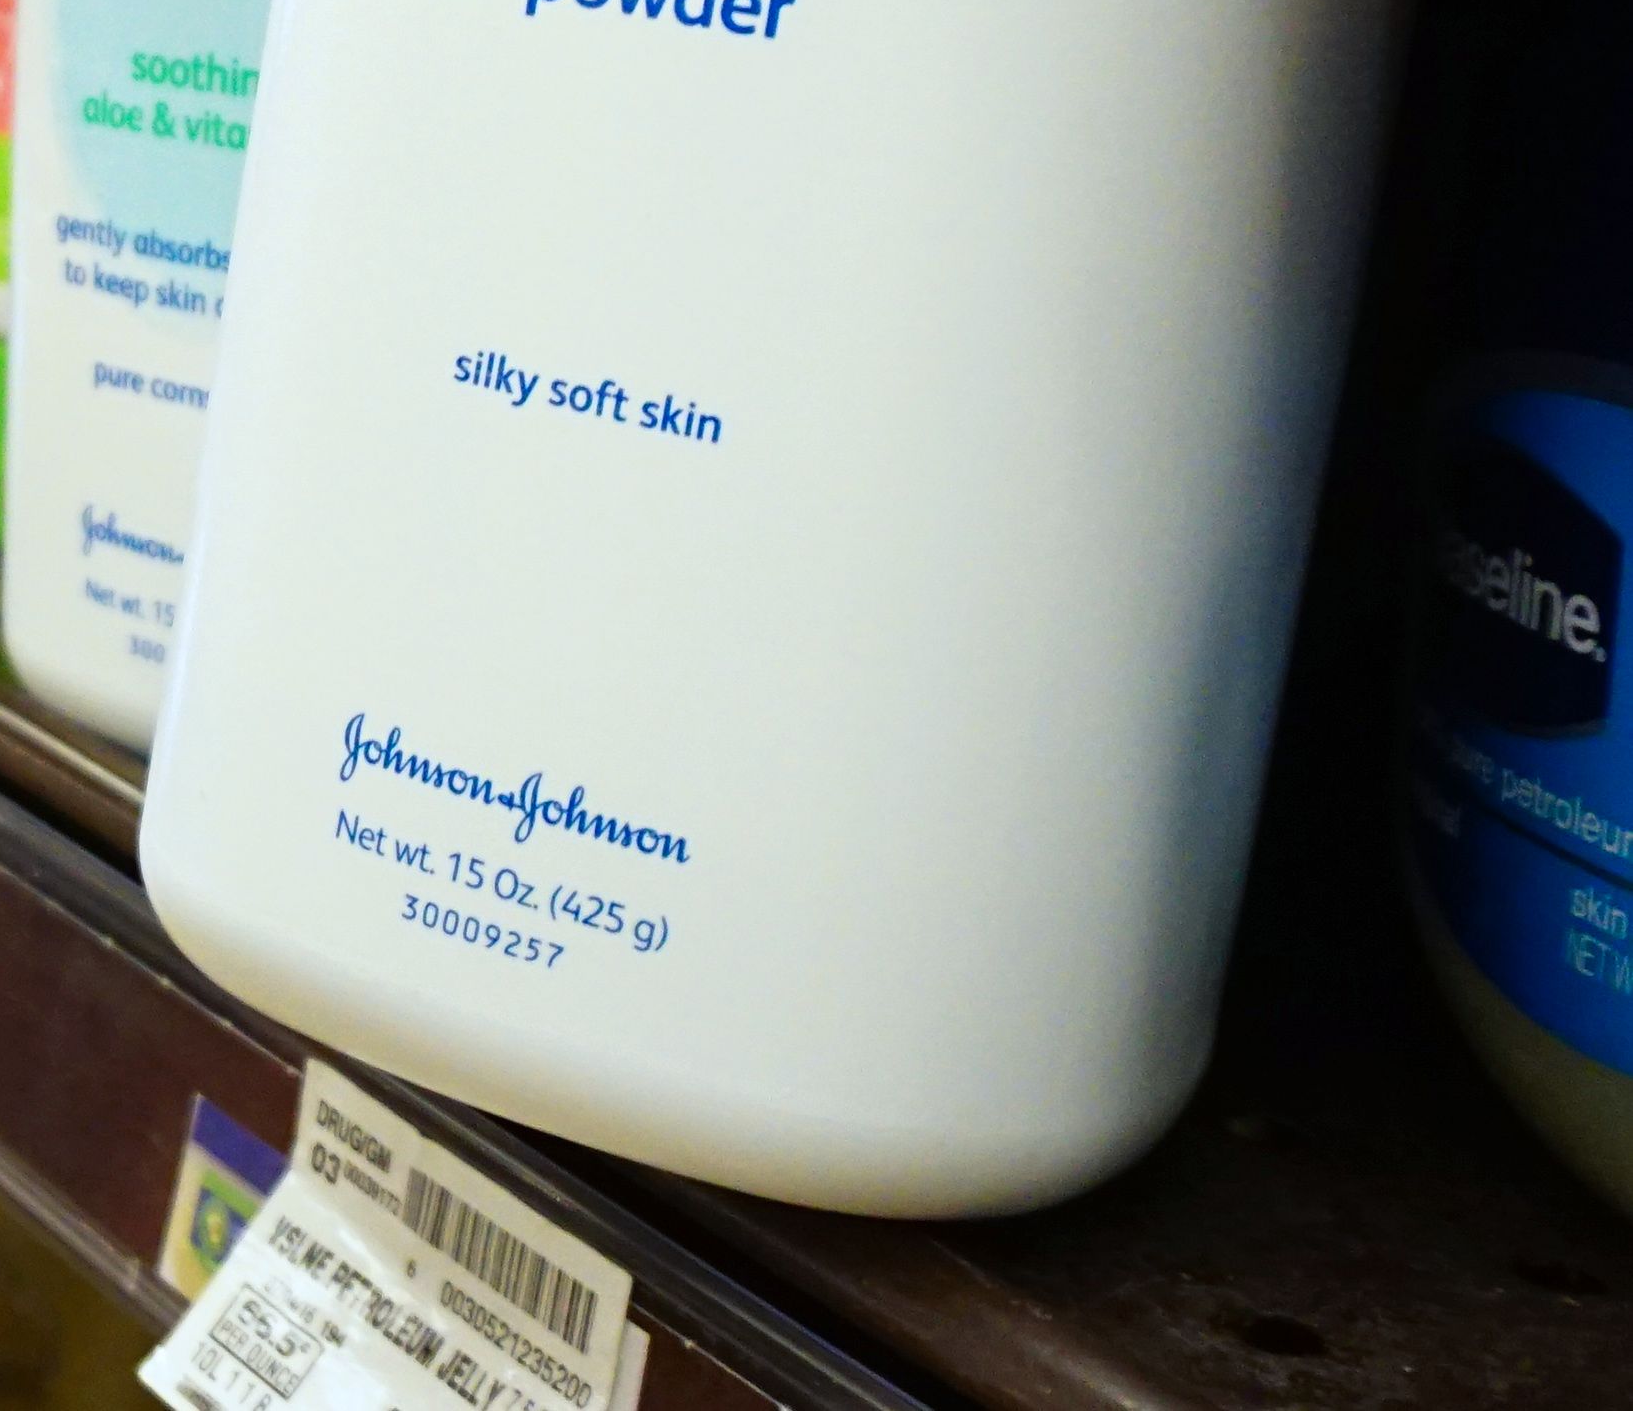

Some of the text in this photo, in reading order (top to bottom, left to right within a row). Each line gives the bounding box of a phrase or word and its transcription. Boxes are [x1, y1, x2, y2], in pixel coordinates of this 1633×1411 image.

[83, 90, 249, 151] aloe & vita
[55, 214, 127, 258] gently
[64, 257, 87, 287] to
[92, 261, 150, 309] keep
[155, 278, 207, 316] skin
[93, 361, 145, 393] pure
[452, 350, 723, 444] silky soft skin
[334, 808, 670, 952] Net wt. 15 Oz. (425 g)
[1570, 881, 1629, 938] skin
[400, 893, 565, 969] 30009257
[1564, 929, 1609, 982] NET
[310, 1141, 341, 1185] 03
[217, 1318, 251, 1355] PER
[246, 1344, 301, 1396] OUNCE
[332, 1261, 445, 1369] PETROLEUM
[436, 1348, 507, 1411] JELLY
